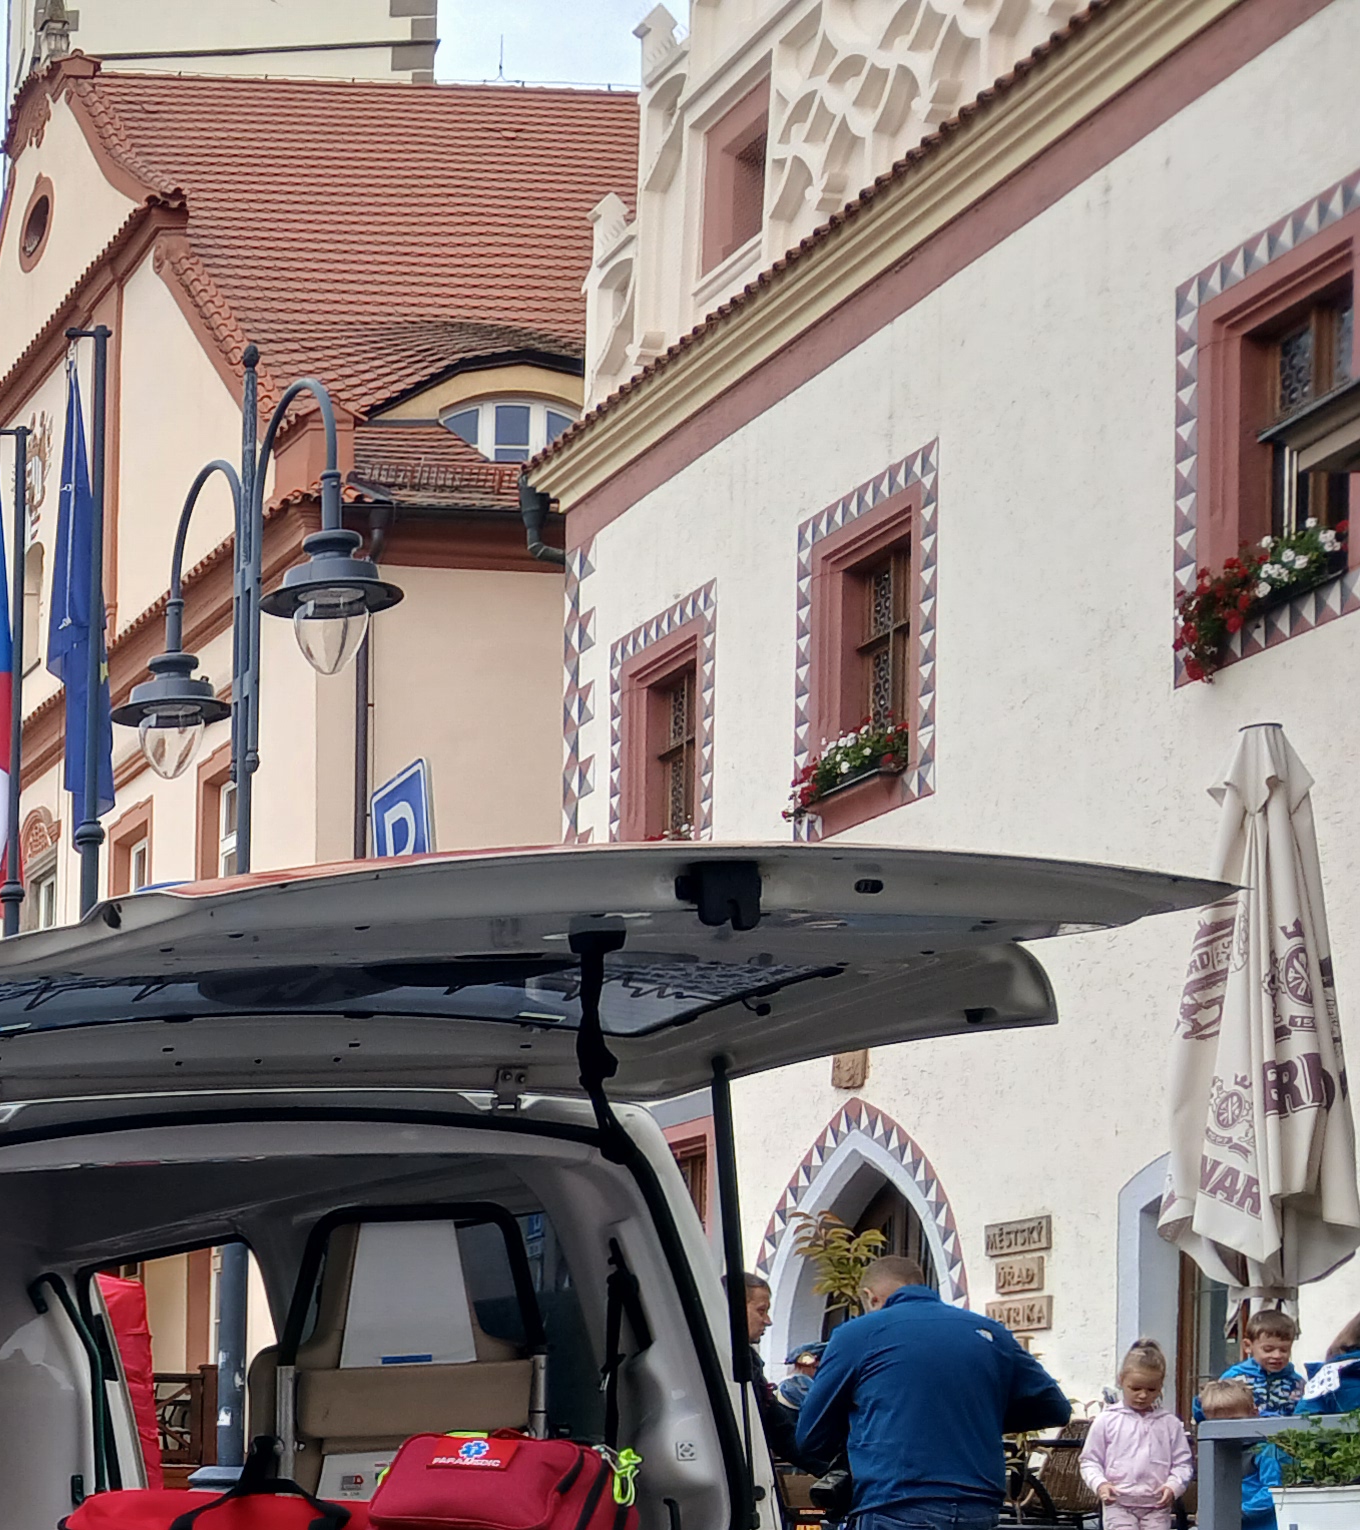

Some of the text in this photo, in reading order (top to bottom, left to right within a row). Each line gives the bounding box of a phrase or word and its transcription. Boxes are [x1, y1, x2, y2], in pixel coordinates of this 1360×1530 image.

[384, 801, 416, 857] P
[985, 1221, 1044, 1251] MĚSTSKÝ
[998, 1265, 1036, 1288] ÚŘAD
[432, 1456, 501, 1467] PARAMEDIC
